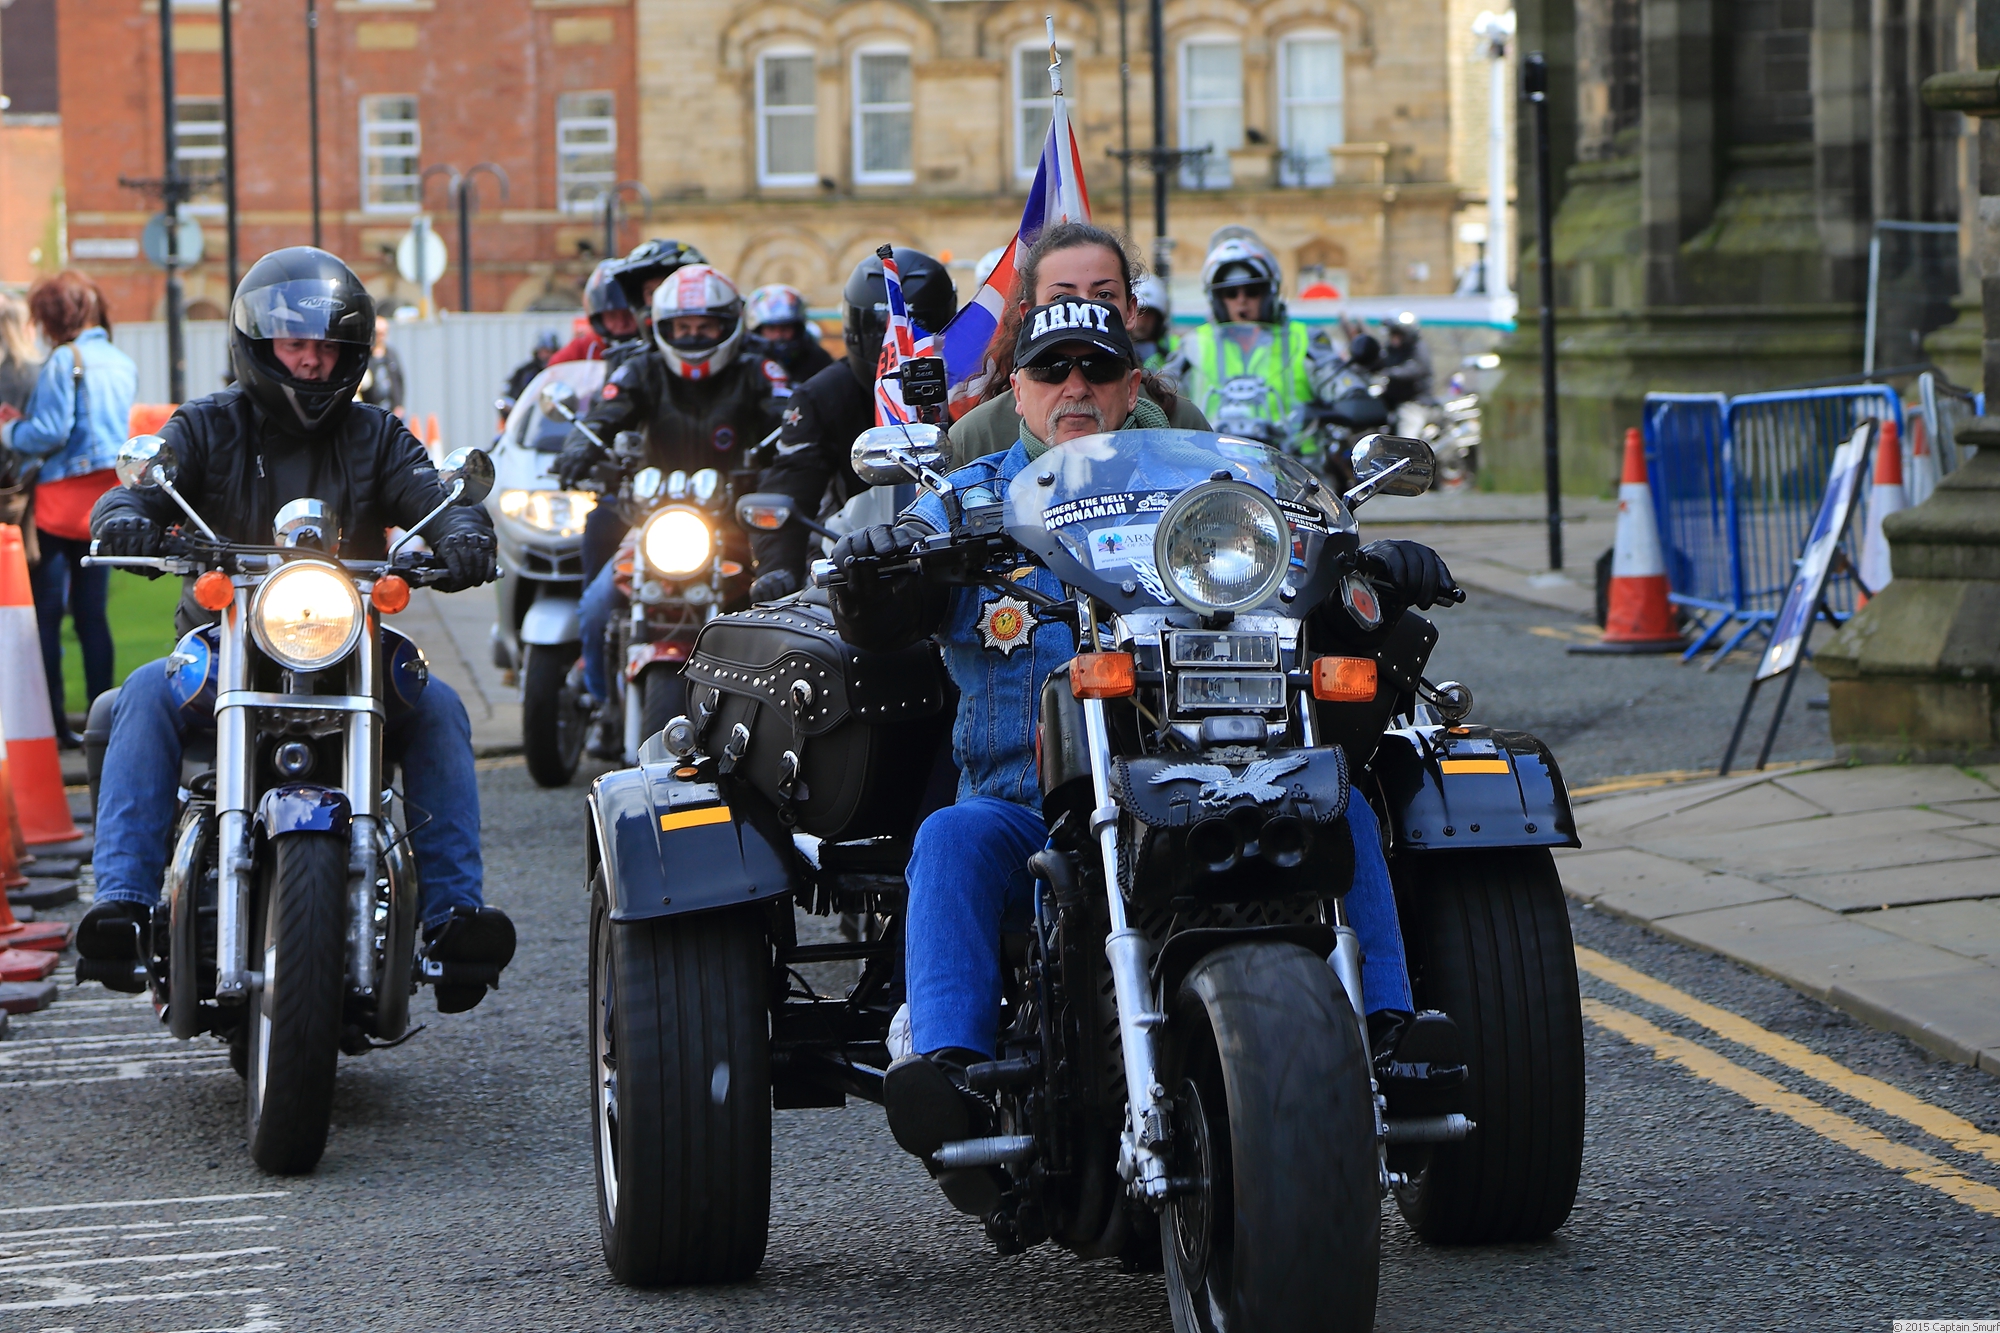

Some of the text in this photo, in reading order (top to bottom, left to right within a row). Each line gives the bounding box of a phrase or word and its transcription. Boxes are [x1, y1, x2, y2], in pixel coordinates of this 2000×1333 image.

[1030, 302, 1110, 341] ARMY
[1043, 493, 1135, 519] WHERE THE HELL'S
[1045, 502, 1127, 531] NOONAMAH
[1285, 516, 1328, 534] TERRITORY
